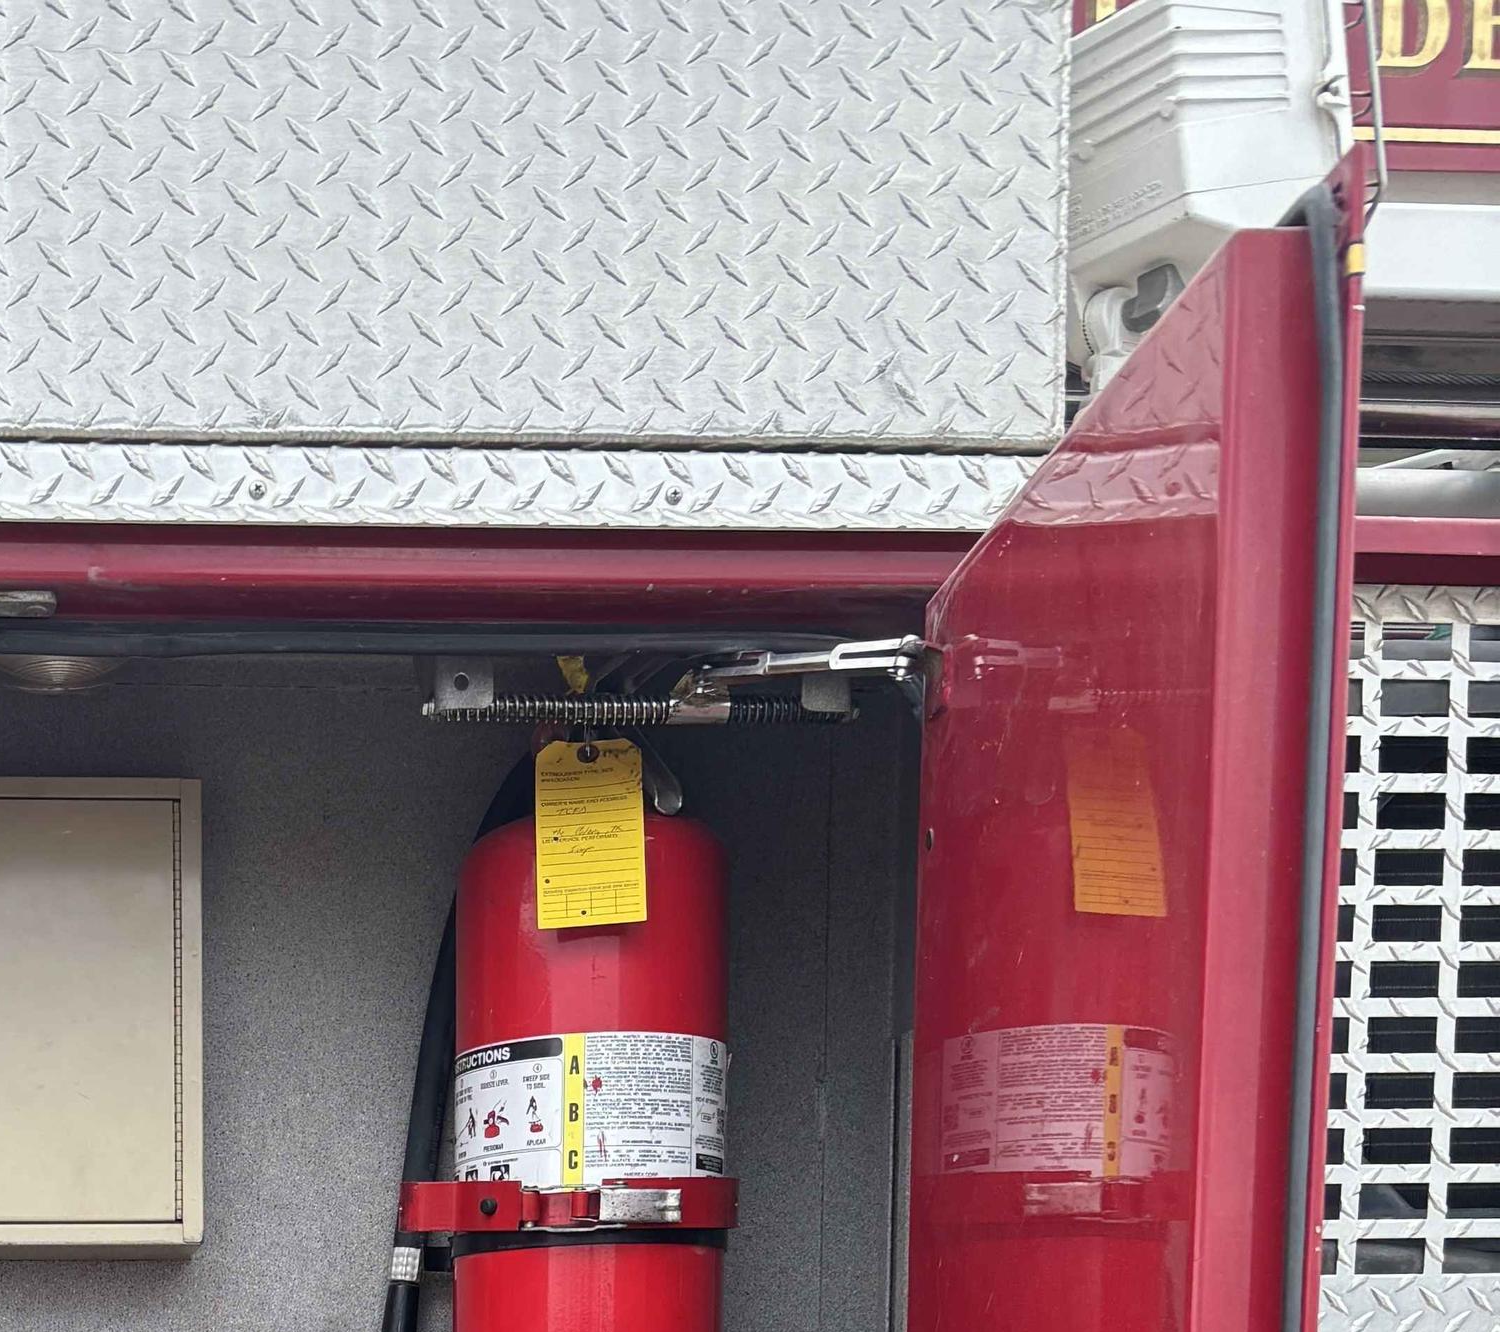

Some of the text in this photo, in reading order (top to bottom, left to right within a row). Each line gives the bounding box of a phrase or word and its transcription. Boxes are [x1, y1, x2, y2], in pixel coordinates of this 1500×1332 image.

[569, 1055, 579, 1075] A
[569, 1103, 579, 1122] B
[568, 1150, 578, 1170] C
